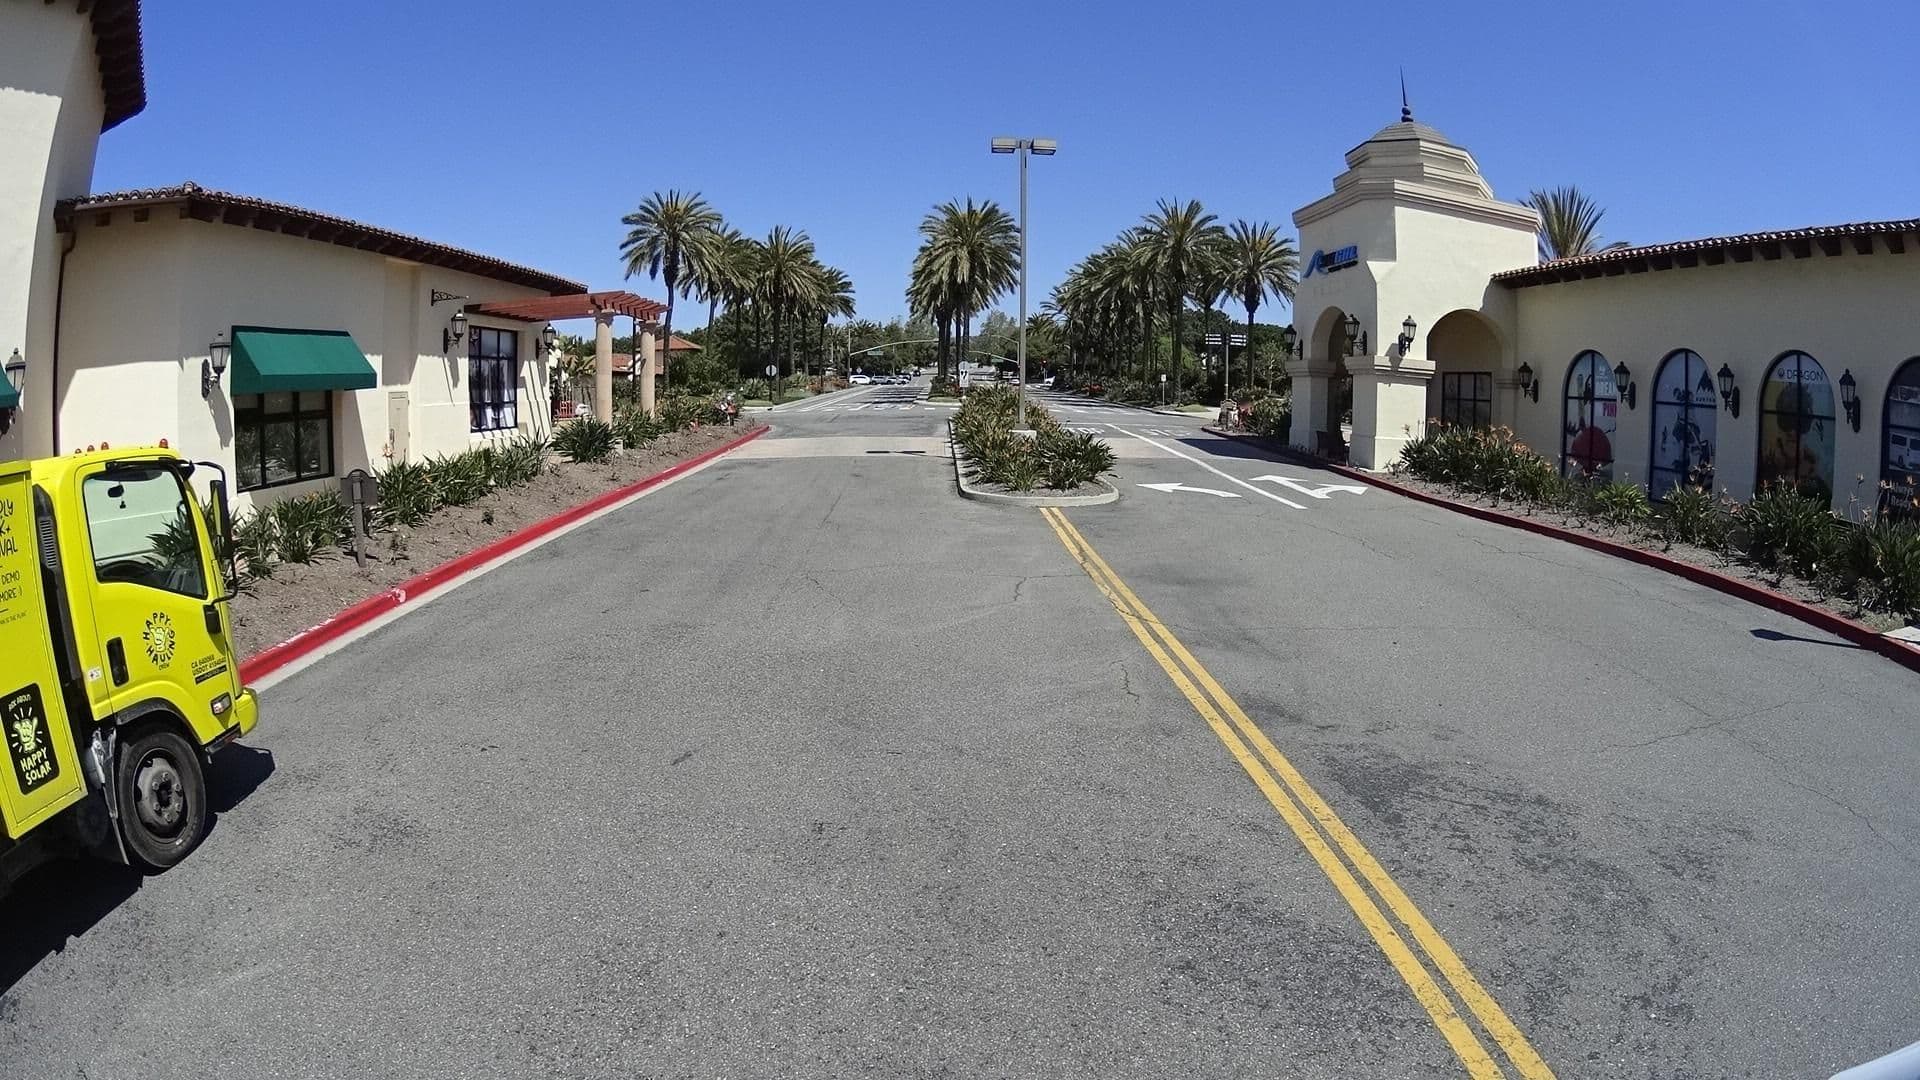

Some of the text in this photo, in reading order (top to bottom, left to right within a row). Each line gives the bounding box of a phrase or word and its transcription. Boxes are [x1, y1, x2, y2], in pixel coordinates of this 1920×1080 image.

[1, 570, 20, 585] DEMO
[143, 612, 171, 641] HAPPY
[146, 630, 176, 665] HAULING
[20, 746, 48, 773] HAPPY
[25, 760, 52, 786] SOLAR
